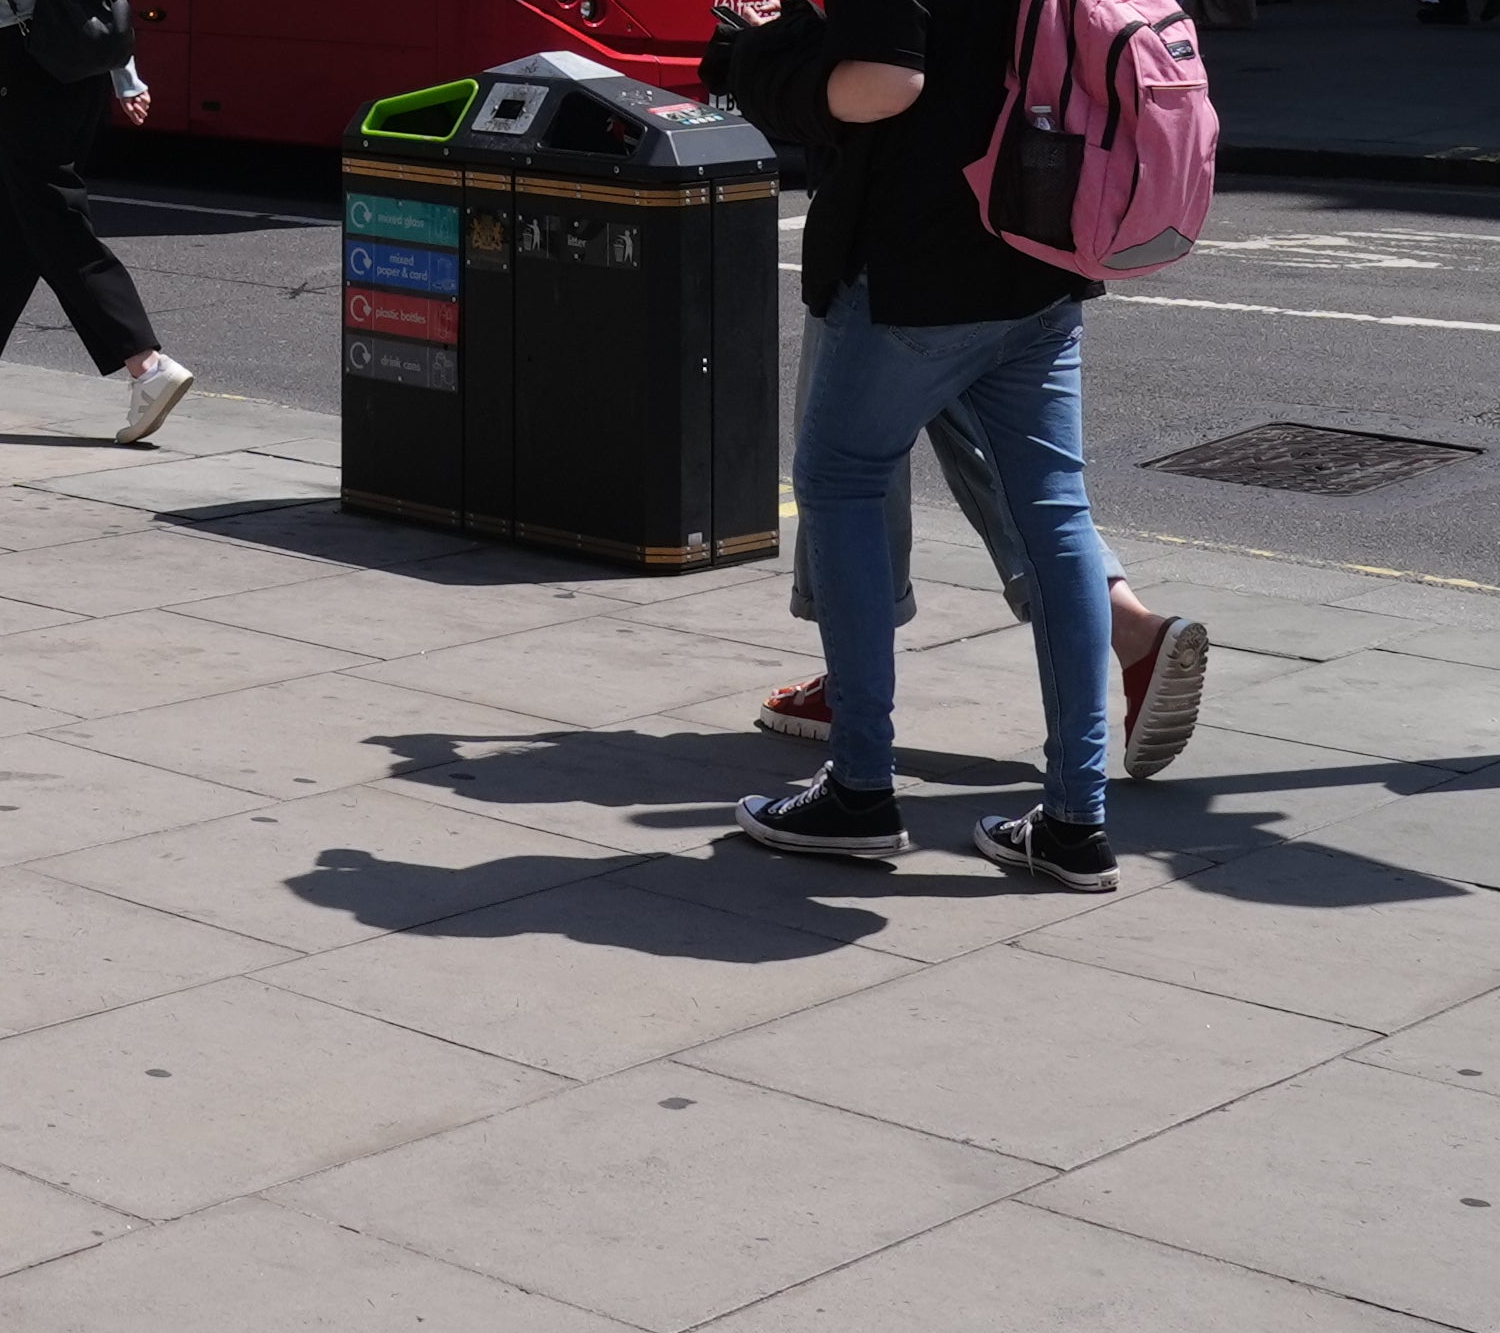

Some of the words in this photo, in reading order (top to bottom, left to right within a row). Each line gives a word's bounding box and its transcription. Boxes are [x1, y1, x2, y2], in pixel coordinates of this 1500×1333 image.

[716, 92, 738, 112] LB
[377, 213, 401, 227] mixed
[403, 216, 425, 230] glass
[567, 234, 587, 248] litter
[389, 253, 414, 267] mixed
[376, 266, 401, 281] paper
[410, 268, 428, 282] card
[375, 306, 398, 322] plastic
[400, 309, 426, 324] bottles
[380, 353, 402, 368] drink
[403, 359, 421, 371] cans
